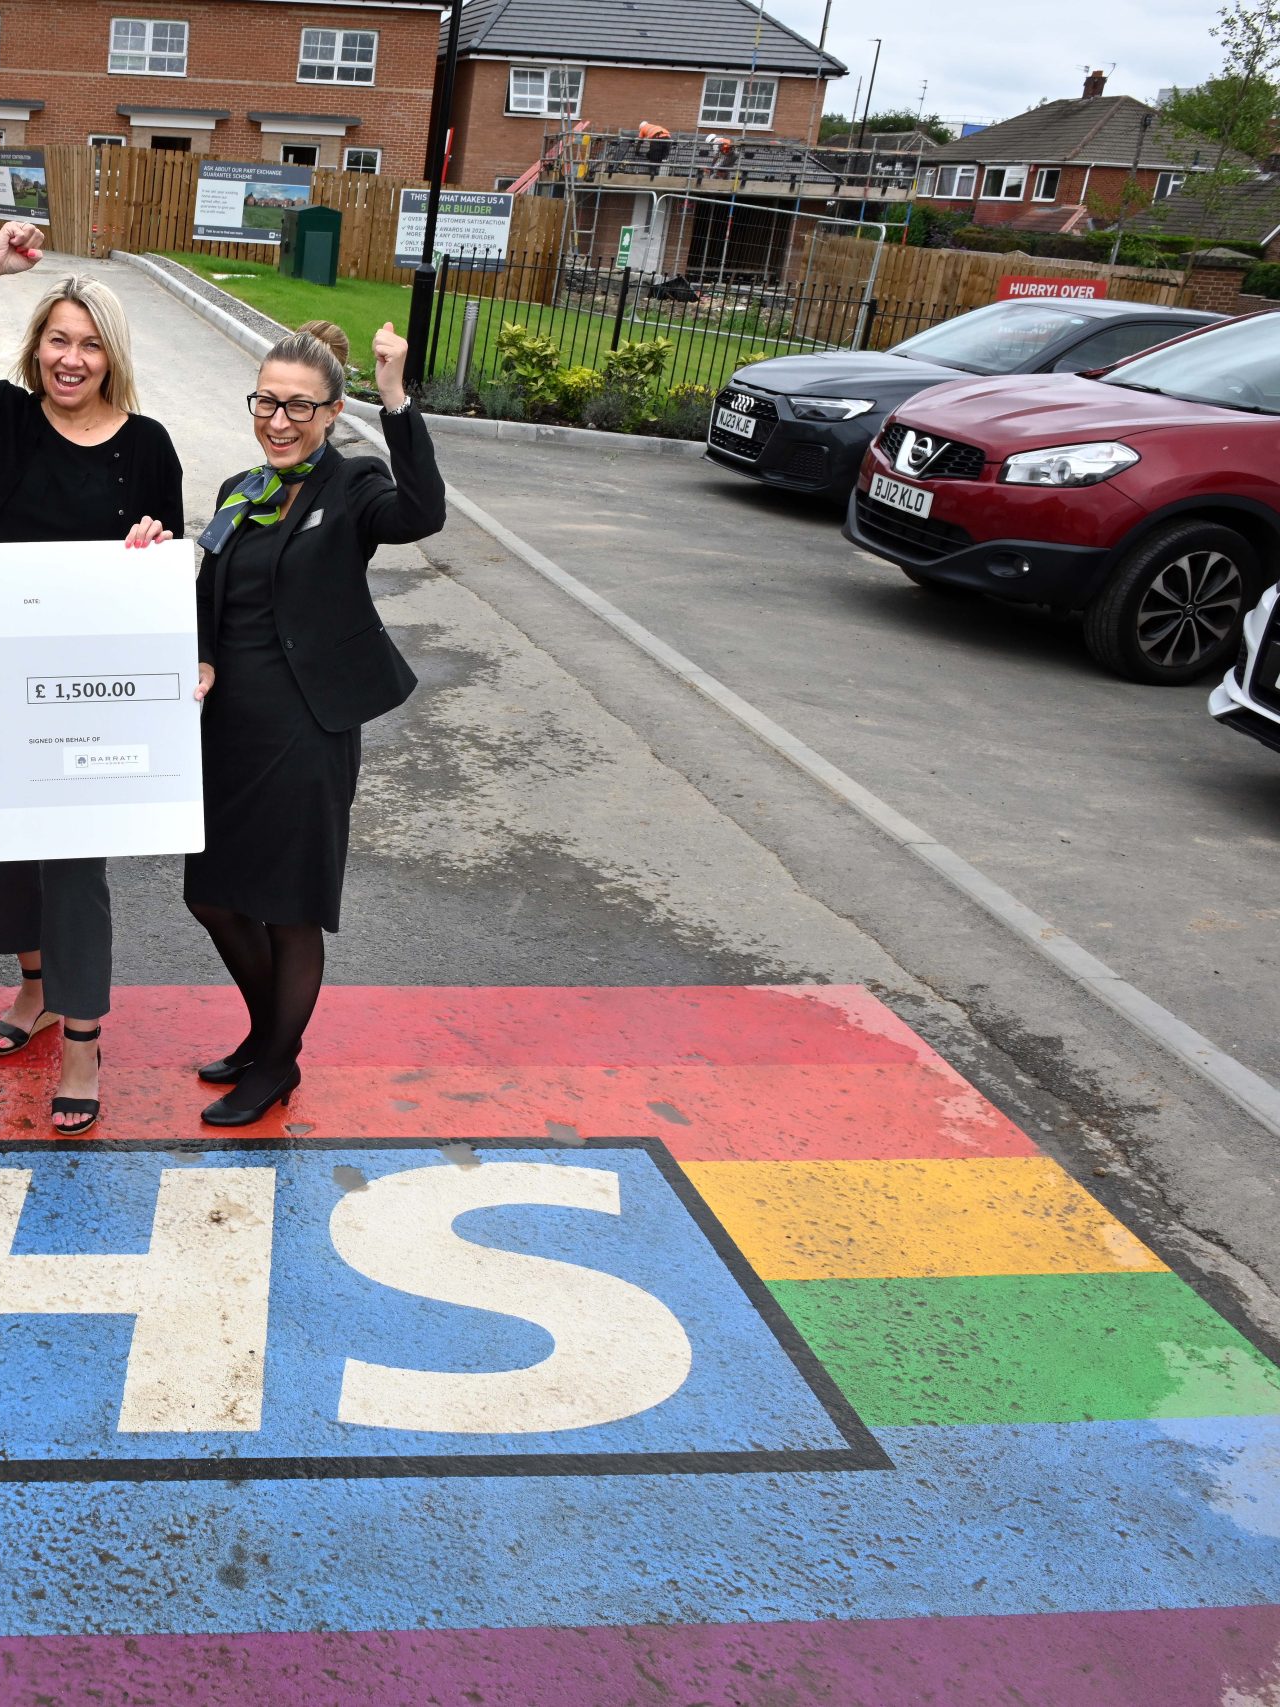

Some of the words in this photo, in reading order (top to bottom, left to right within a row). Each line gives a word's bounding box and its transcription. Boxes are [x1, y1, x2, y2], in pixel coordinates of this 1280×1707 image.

[460, 195, 486, 204] MAKES
[421, 203, 426, 212] 5
[454, 204, 492, 214] BUILDER
[1009, 282, 1058, 296] HURRY!
[1060, 285, 1096, 299] OVER
[718, 411, 736, 428] NJ23
[736, 416, 752, 434] KJE
[874, 478, 899, 503] BJ12
[898, 486, 924, 512] KLO
[35, 684, 46, 698] £
[55, 682, 136, 700] 1,500.00
